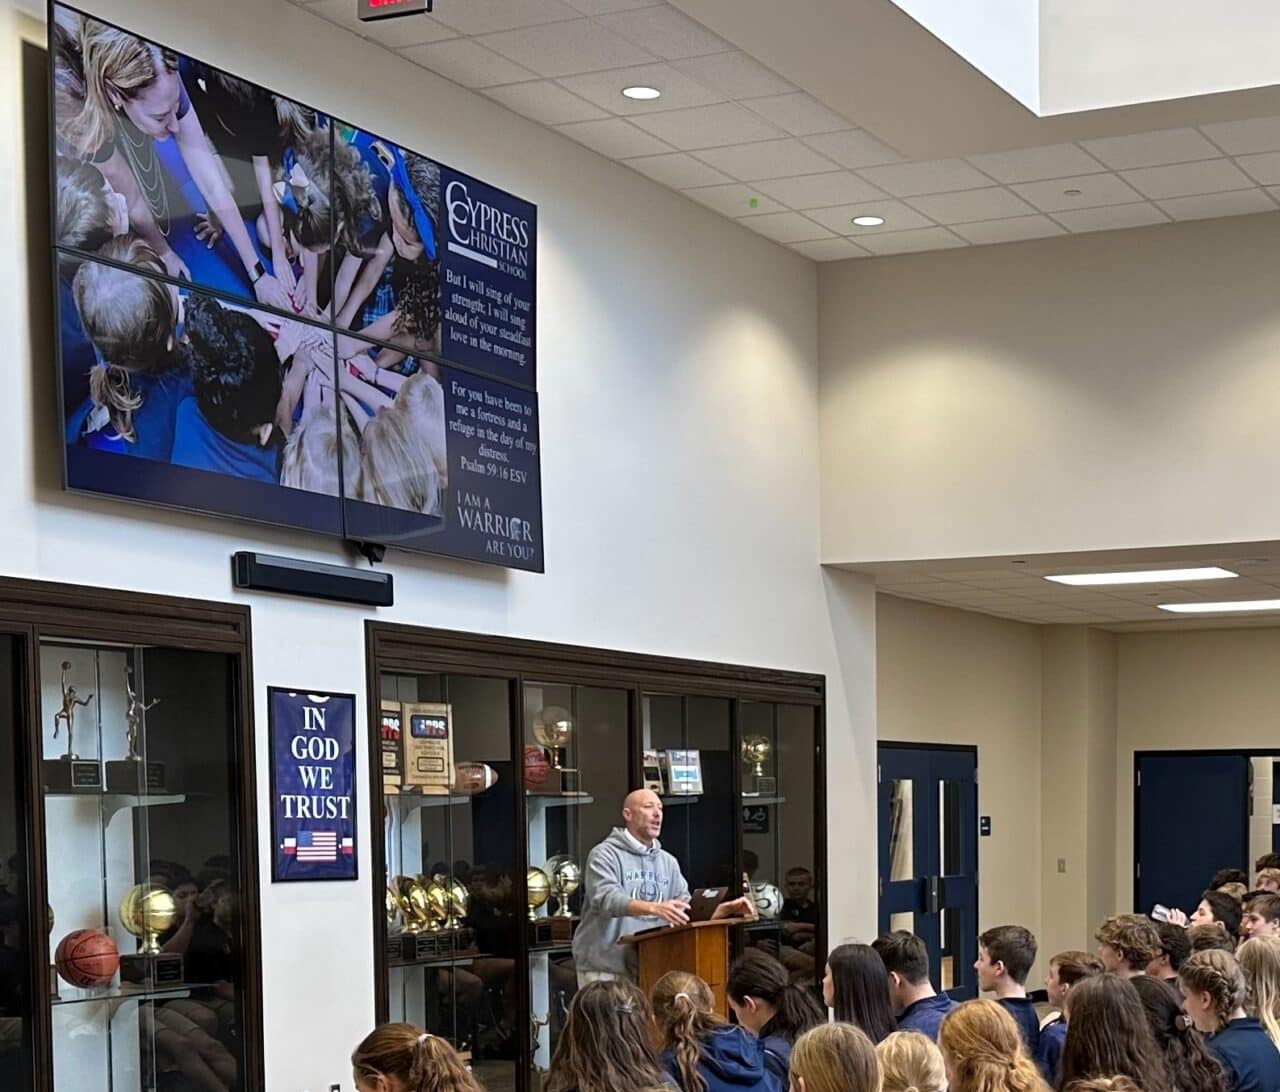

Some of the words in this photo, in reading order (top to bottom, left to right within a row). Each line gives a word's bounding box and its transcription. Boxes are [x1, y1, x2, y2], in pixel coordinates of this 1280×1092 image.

[446, 181, 528, 248] CYPRESS
[451, 201, 528, 268] CHRISTIAN
[499, 261, 527, 280] SCHOOL
[446, 269, 461, 287] But
[468, 280, 484, 296] will
[486, 285, 502, 305] sing
[504, 292, 512, 305] of
[513, 297, 531, 312] your
[445, 307, 468, 326] aloud
[469, 317, 479, 329] of
[480, 321, 497, 335] your
[494, 308, 509, 322] will
[450, 326, 468, 344] love
[470, 333, 478, 348] in
[480, 337, 492, 352] the
[452, 381, 466, 398] For
[468, 389, 483, 402] you
[485, 390, 503, 409] have
[505, 396, 522, 414] been
[524, 405, 532, 417] to
[456, 404, 469, 416] me
[470, 408, 476, 418] a
[478, 407, 506, 426] fortress
[508, 418, 521, 431] and
[449, 419, 475, 438] refuge
[477, 425, 485, 438] in
[487, 427, 499, 442] the
[500, 431, 514, 449] day
[515, 437, 524, 449] of
[461, 456, 485, 474] Psalm
[510, 468, 527, 484] ESV
[457, 489, 461, 505] I
[464, 492, 481, 508] AM
[484, 497, 491, 511] A
[486, 540, 504, 556] ARE
[507, 543, 534, 560] YOU?
[302, 706, 327, 731] IN
[291, 735, 339, 760] GOD
[299, 766, 333, 790] WE
[281, 795, 350, 819] TRUST
